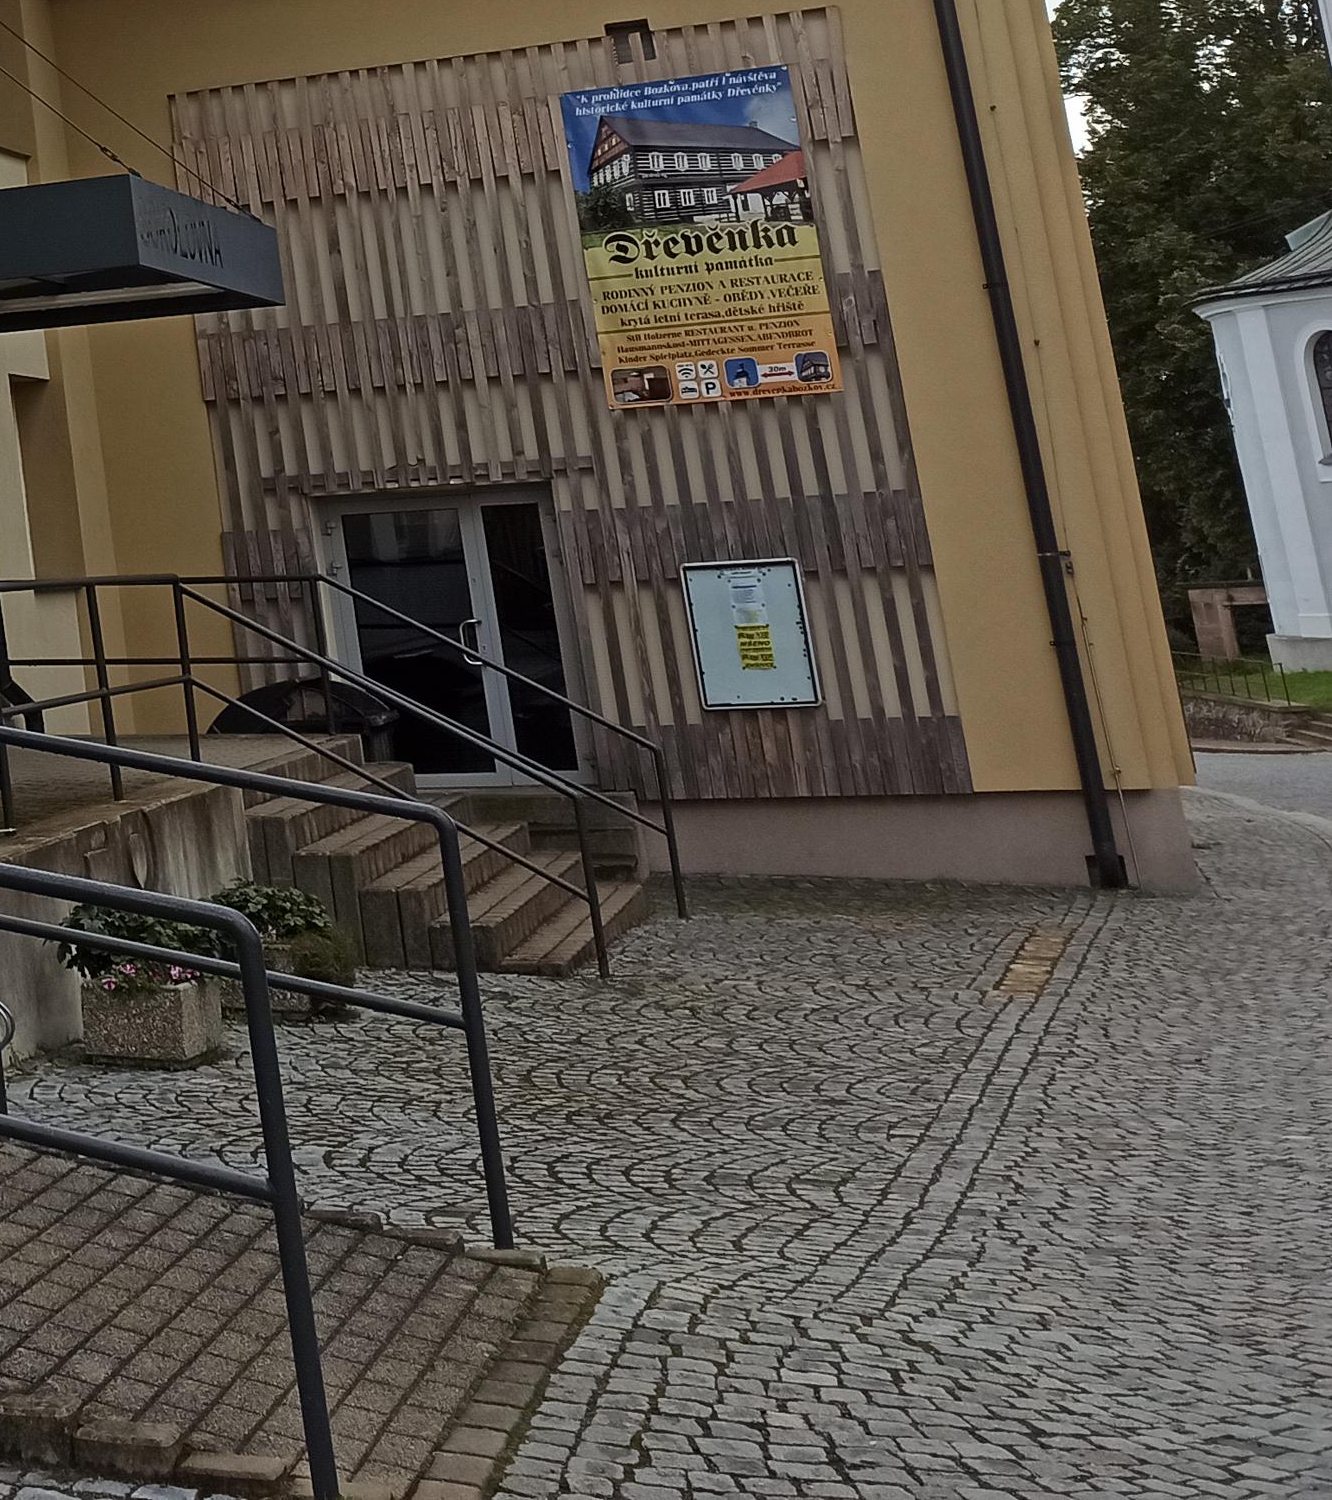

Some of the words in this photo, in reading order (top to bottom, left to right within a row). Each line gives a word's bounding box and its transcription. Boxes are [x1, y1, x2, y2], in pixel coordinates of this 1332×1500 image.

[630, 96, 675, 110] kulturní
[677, 91, 724, 106] památky
[604, 218, 800, 265] Dřevěnka
[634, 261, 700, 280] kulturní
[704, 254, 774, 276] památka
[601, 284, 657, 301] RODINNÝ
[660, 280, 715, 296] PENZION
[718, 279, 728, 290] A
[730, 271, 814, 288] RESTAURACE
[601, 300, 650, 316] DOMÁCÍ
[652, 293, 712, 311] KUCHYNĚ
[620, 313, 651, 328] krytá
[654, 311, 681, 324] letní
[768, 301, 805, 314] hřiště
[684, 324, 745, 337] RESTAURANT
[759, 319, 800, 331] PENZION
[618, 355, 648, 364] Kinder
[738, 343, 775, 353] Sommer
[776, 340, 817, 350] Terrasse
